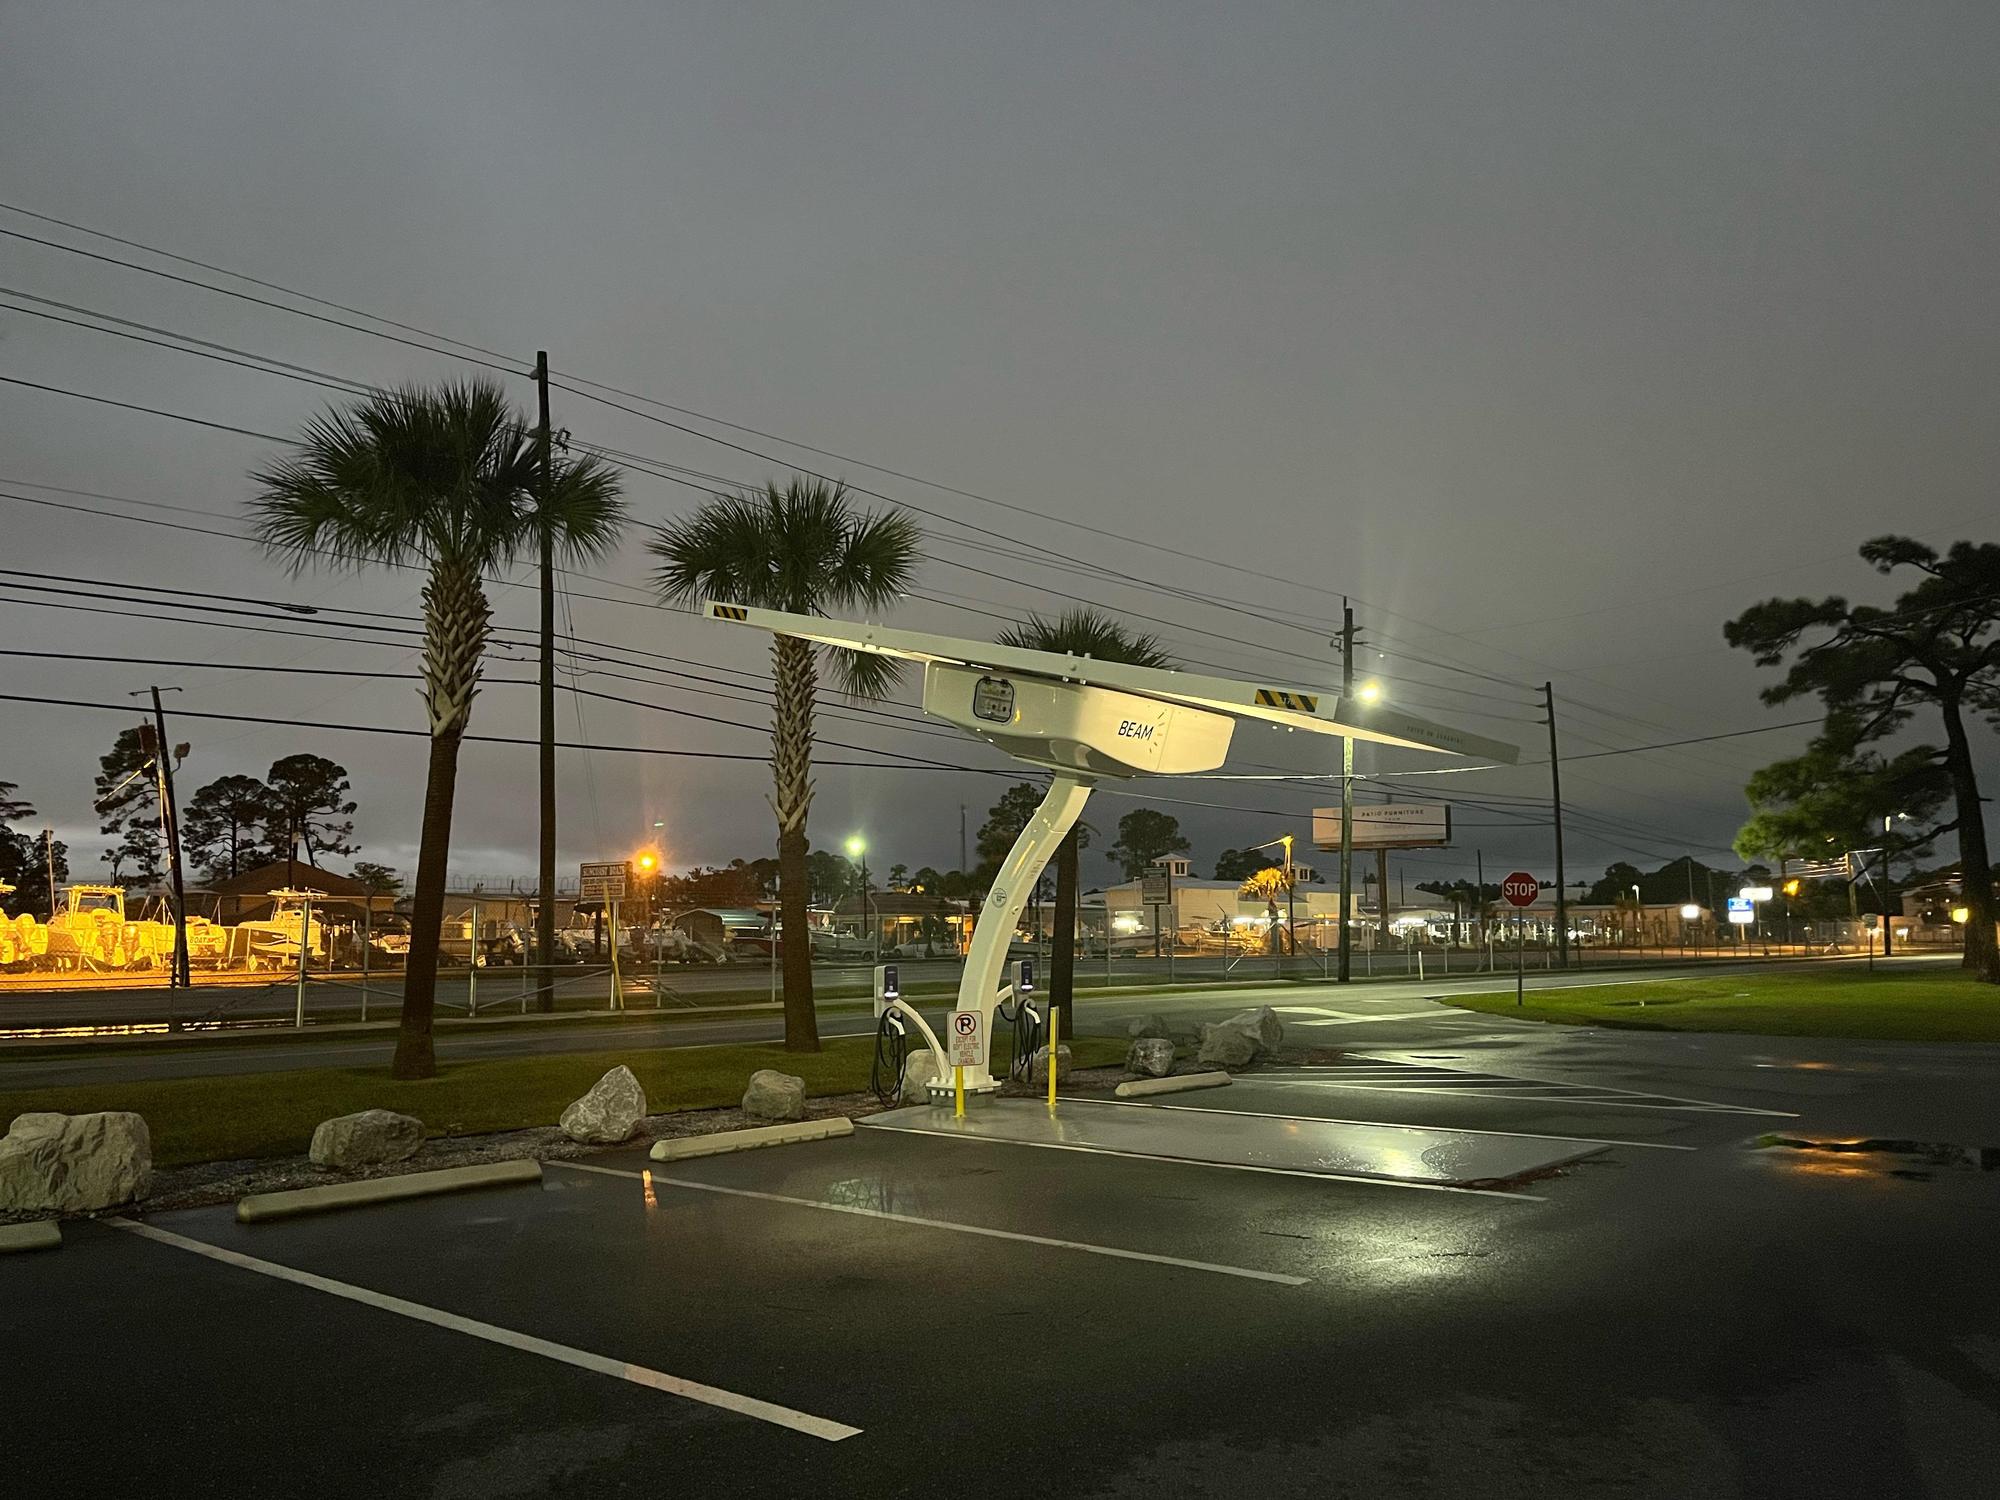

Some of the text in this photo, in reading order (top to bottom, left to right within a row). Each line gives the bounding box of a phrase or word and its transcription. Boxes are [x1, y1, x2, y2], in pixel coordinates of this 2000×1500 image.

[1118, 720, 1154, 740] BEAM
[1505, 882, 1536, 896] STOP
[960, 1017, 971, 1031] P
